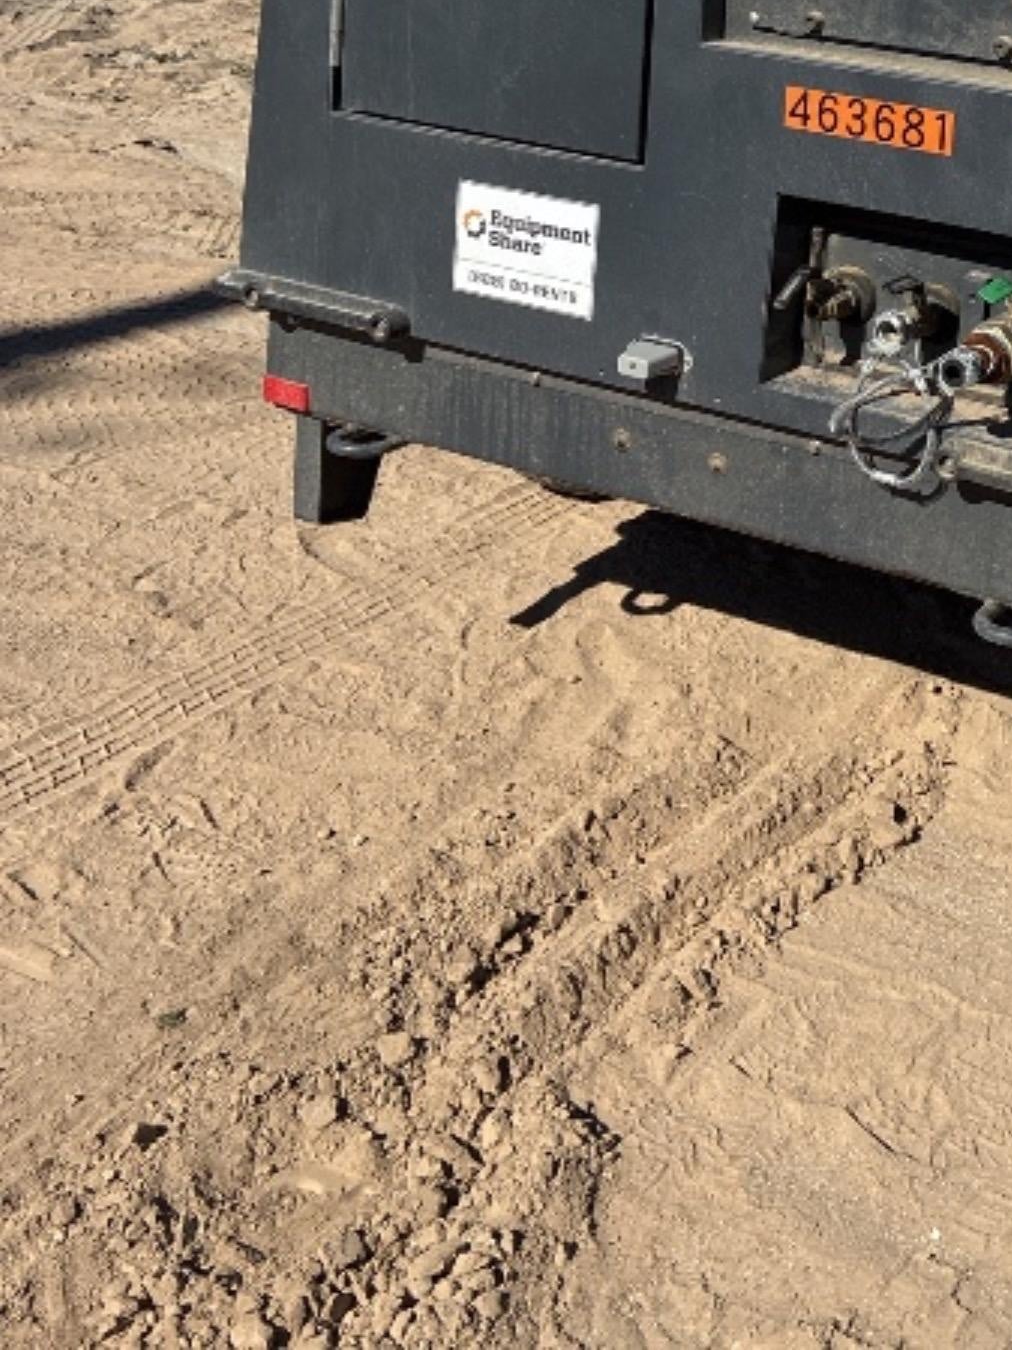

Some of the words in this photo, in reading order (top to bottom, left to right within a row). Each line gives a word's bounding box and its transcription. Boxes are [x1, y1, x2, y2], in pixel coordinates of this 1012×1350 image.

[788, 90, 947, 151] 463681
[488, 230, 542, 256] Share
[490, 209, 592, 247] Equipment
